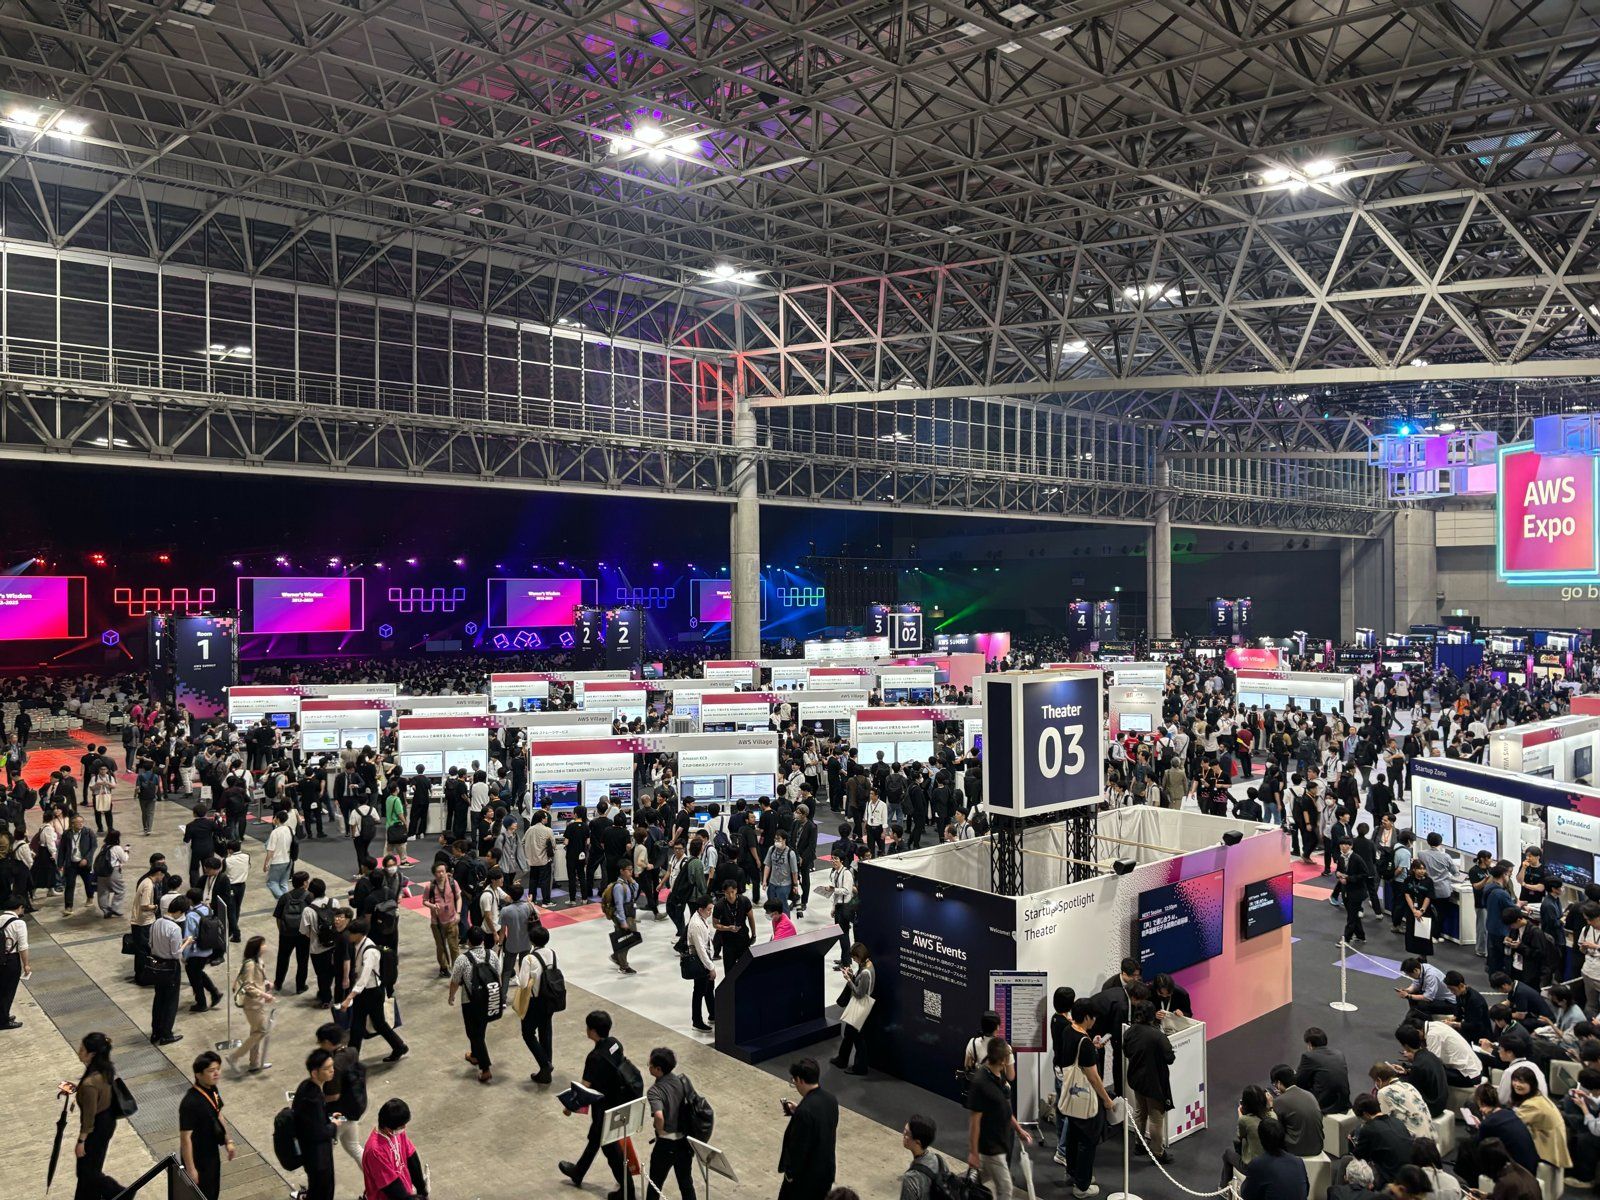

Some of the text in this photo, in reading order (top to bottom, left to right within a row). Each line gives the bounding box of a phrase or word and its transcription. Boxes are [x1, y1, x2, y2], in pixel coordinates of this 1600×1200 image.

[1523, 476, 1576, 507] AWS
[1523, 514, 1576, 543] Expo
[1561, 586, 1583, 601] go
[1077, 614, 1086, 627] 4
[1104, 614, 1111, 626] 4
[1218, 610, 1225, 622] 5
[1242, 610, 1247, 622] 5
[875, 620, 882, 633] 3
[902, 627, 917, 642] 02
[583, 627, 590, 644] 2
[618, 627, 629, 644] 2
[197, 639, 209, 660] 1
[1041, 703, 1082, 720] Theater
[1038, 723, 1086, 779] 03
[1415, 764, 1447, 778] Startup Zone
[1058, 892, 1095, 914] Spotlight
[1024, 923, 1058, 941] Theater
[912, 935, 968, 961] AWS Events
[486, 981, 500, 1017] CHUMS
